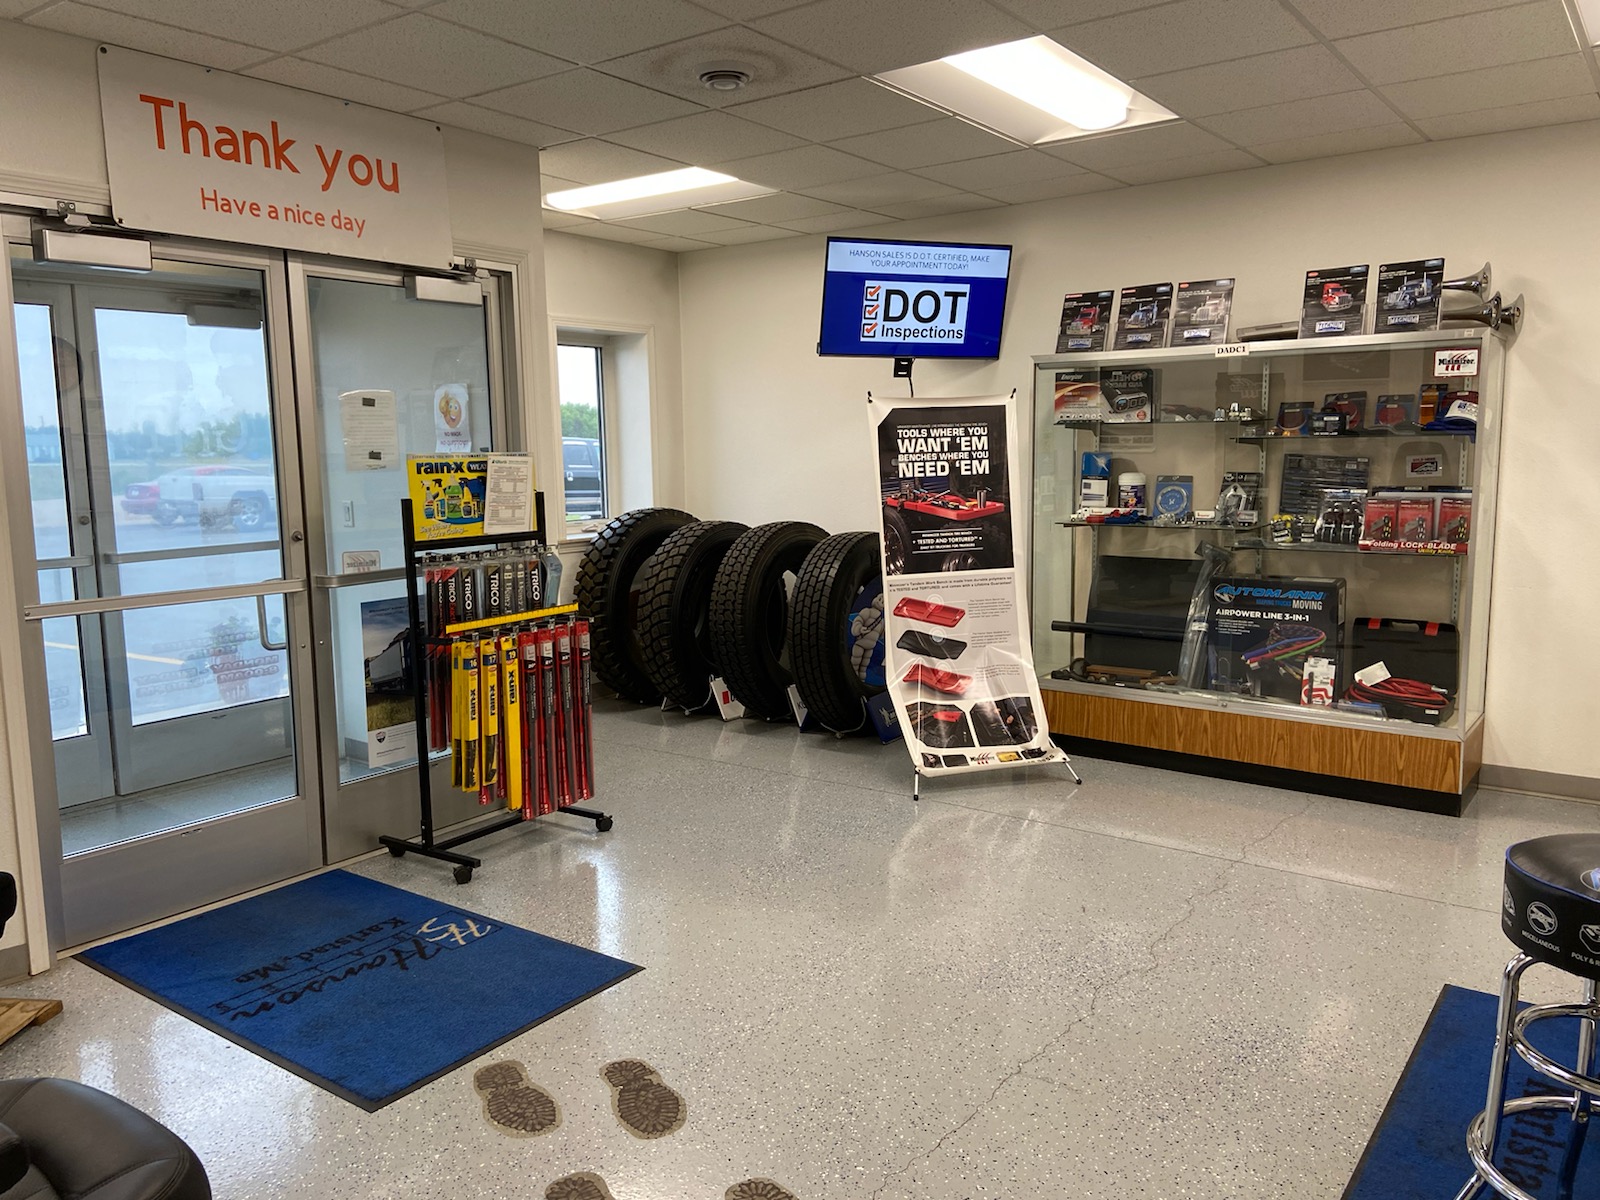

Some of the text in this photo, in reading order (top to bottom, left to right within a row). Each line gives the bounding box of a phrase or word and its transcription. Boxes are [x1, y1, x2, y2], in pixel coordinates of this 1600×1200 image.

[140, 93, 400, 194] Thank you
[200, 187, 366, 238] Have a nice day
[850, 250, 882, 258] HANSON
[882, 251, 904, 260] SALES
[970, 255, 990, 263] MAKE
[870, 260, 969, 270] YOUR APPOINTMENT TODAY!
[883, 288, 968, 324] DOT
[882, 324, 964, 340] Inspections
[897, 427, 988, 438] TOOLS WHERE YOU
[897, 438, 951, 453] WANT
[898, 452, 937, 462] BENCHES
[939, 452, 970, 460] WHERE
[899, 461, 949, 478] NEED
[1400, 541, 1457, 550] LOCK-BLADE
[448, 577, 456, 602] TRICO
[490, 573, 499, 606] TRICO
[532, 569, 540, 600] TRICO
[1216, 586, 1325, 600] AUTOMANN
[1292, 600, 1323, 610] MOVING
[1216, 608, 1309, 621] AIRPOWER LINE 3-IN-1
[1522, 930, 1560, 953] MISCELLANEOUS
[1571, 952, 1589, 962] POLY
[230, 938, 443, 1022] Hanson
